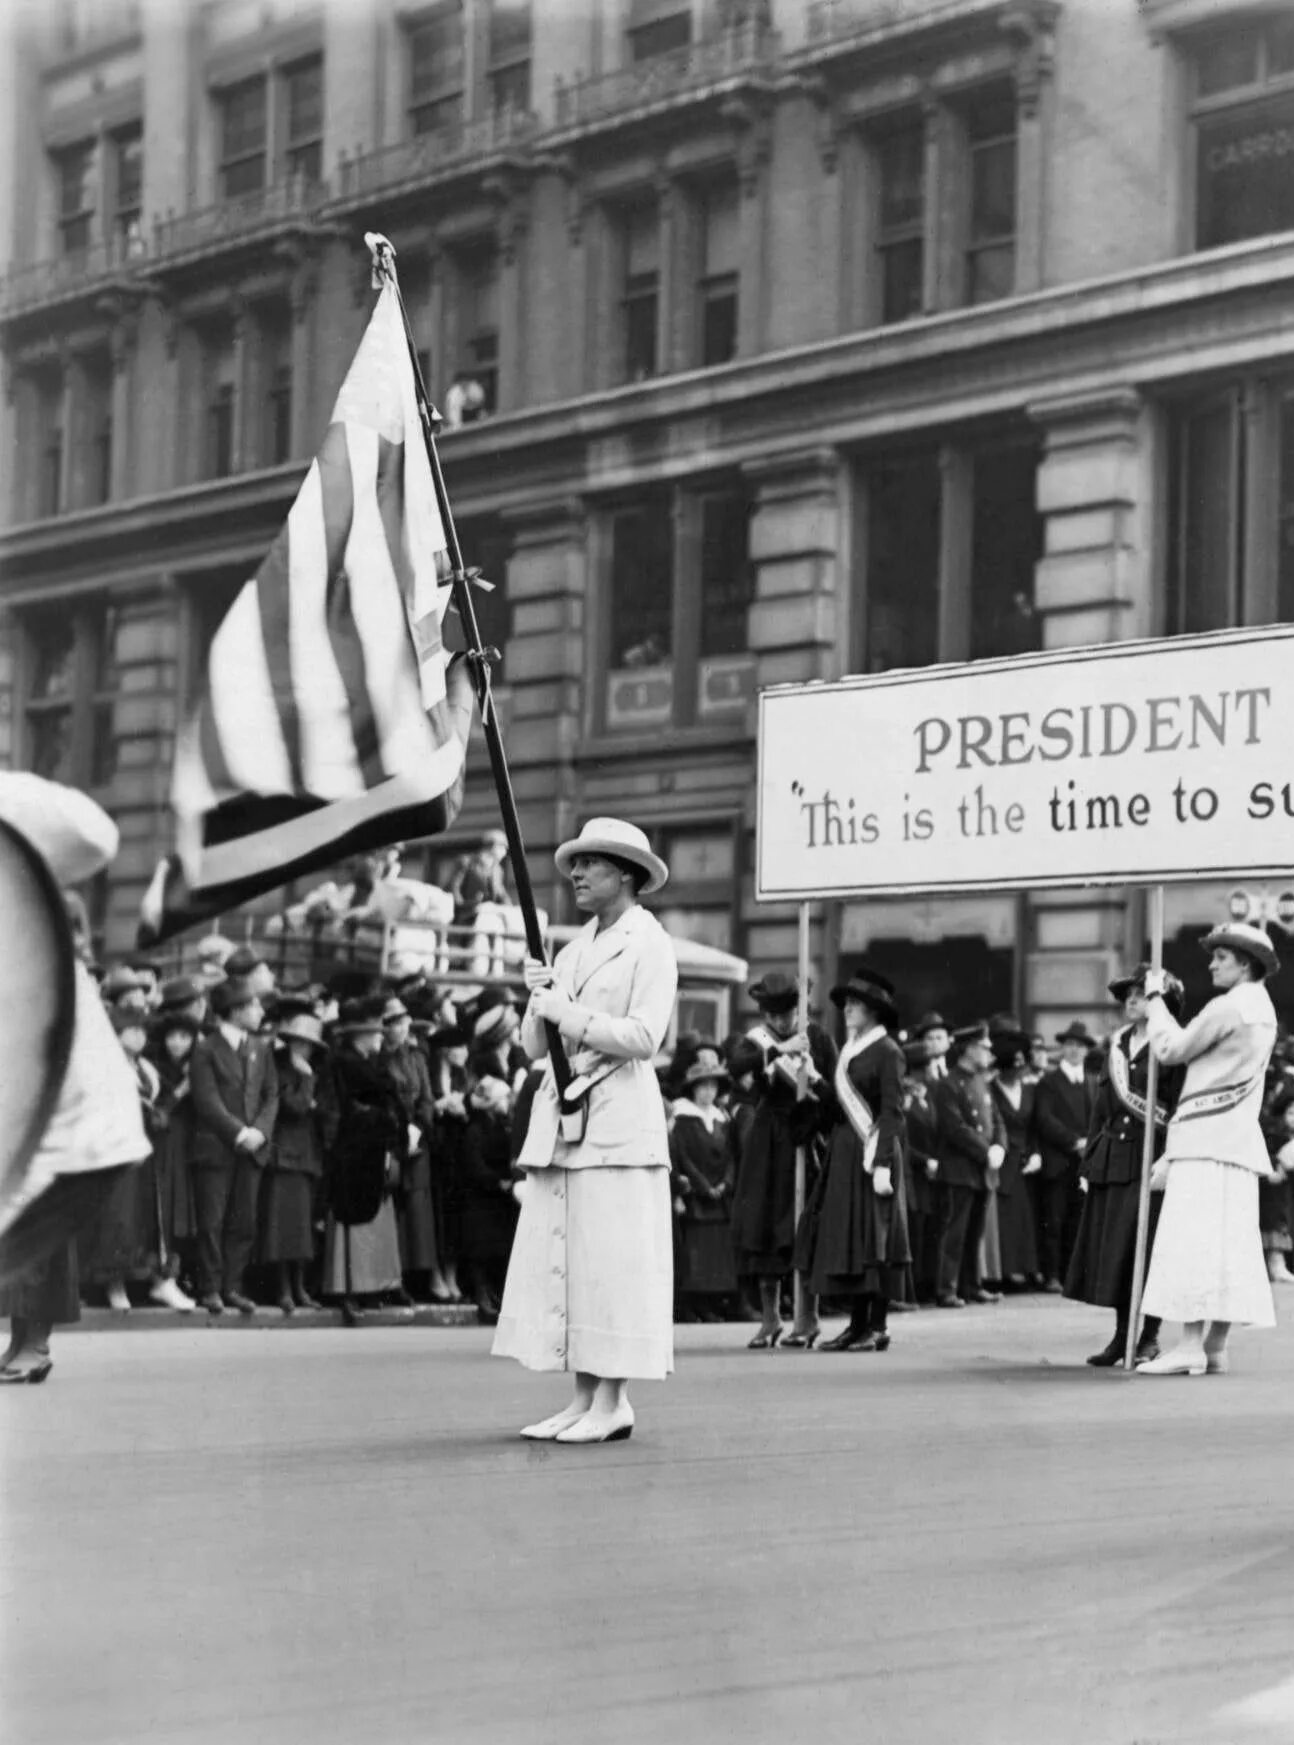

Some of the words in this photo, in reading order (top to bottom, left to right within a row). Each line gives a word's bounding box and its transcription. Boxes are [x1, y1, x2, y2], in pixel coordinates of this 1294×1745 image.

[912, 688, 1270, 773] PRESIDENT
[791, 780, 879, 847] “This
[903, 793, 934, 841] is
[958, 785, 1025, 836] the
[1049, 780, 1151, 832] time
[1172, 778, 1219, 823] to
